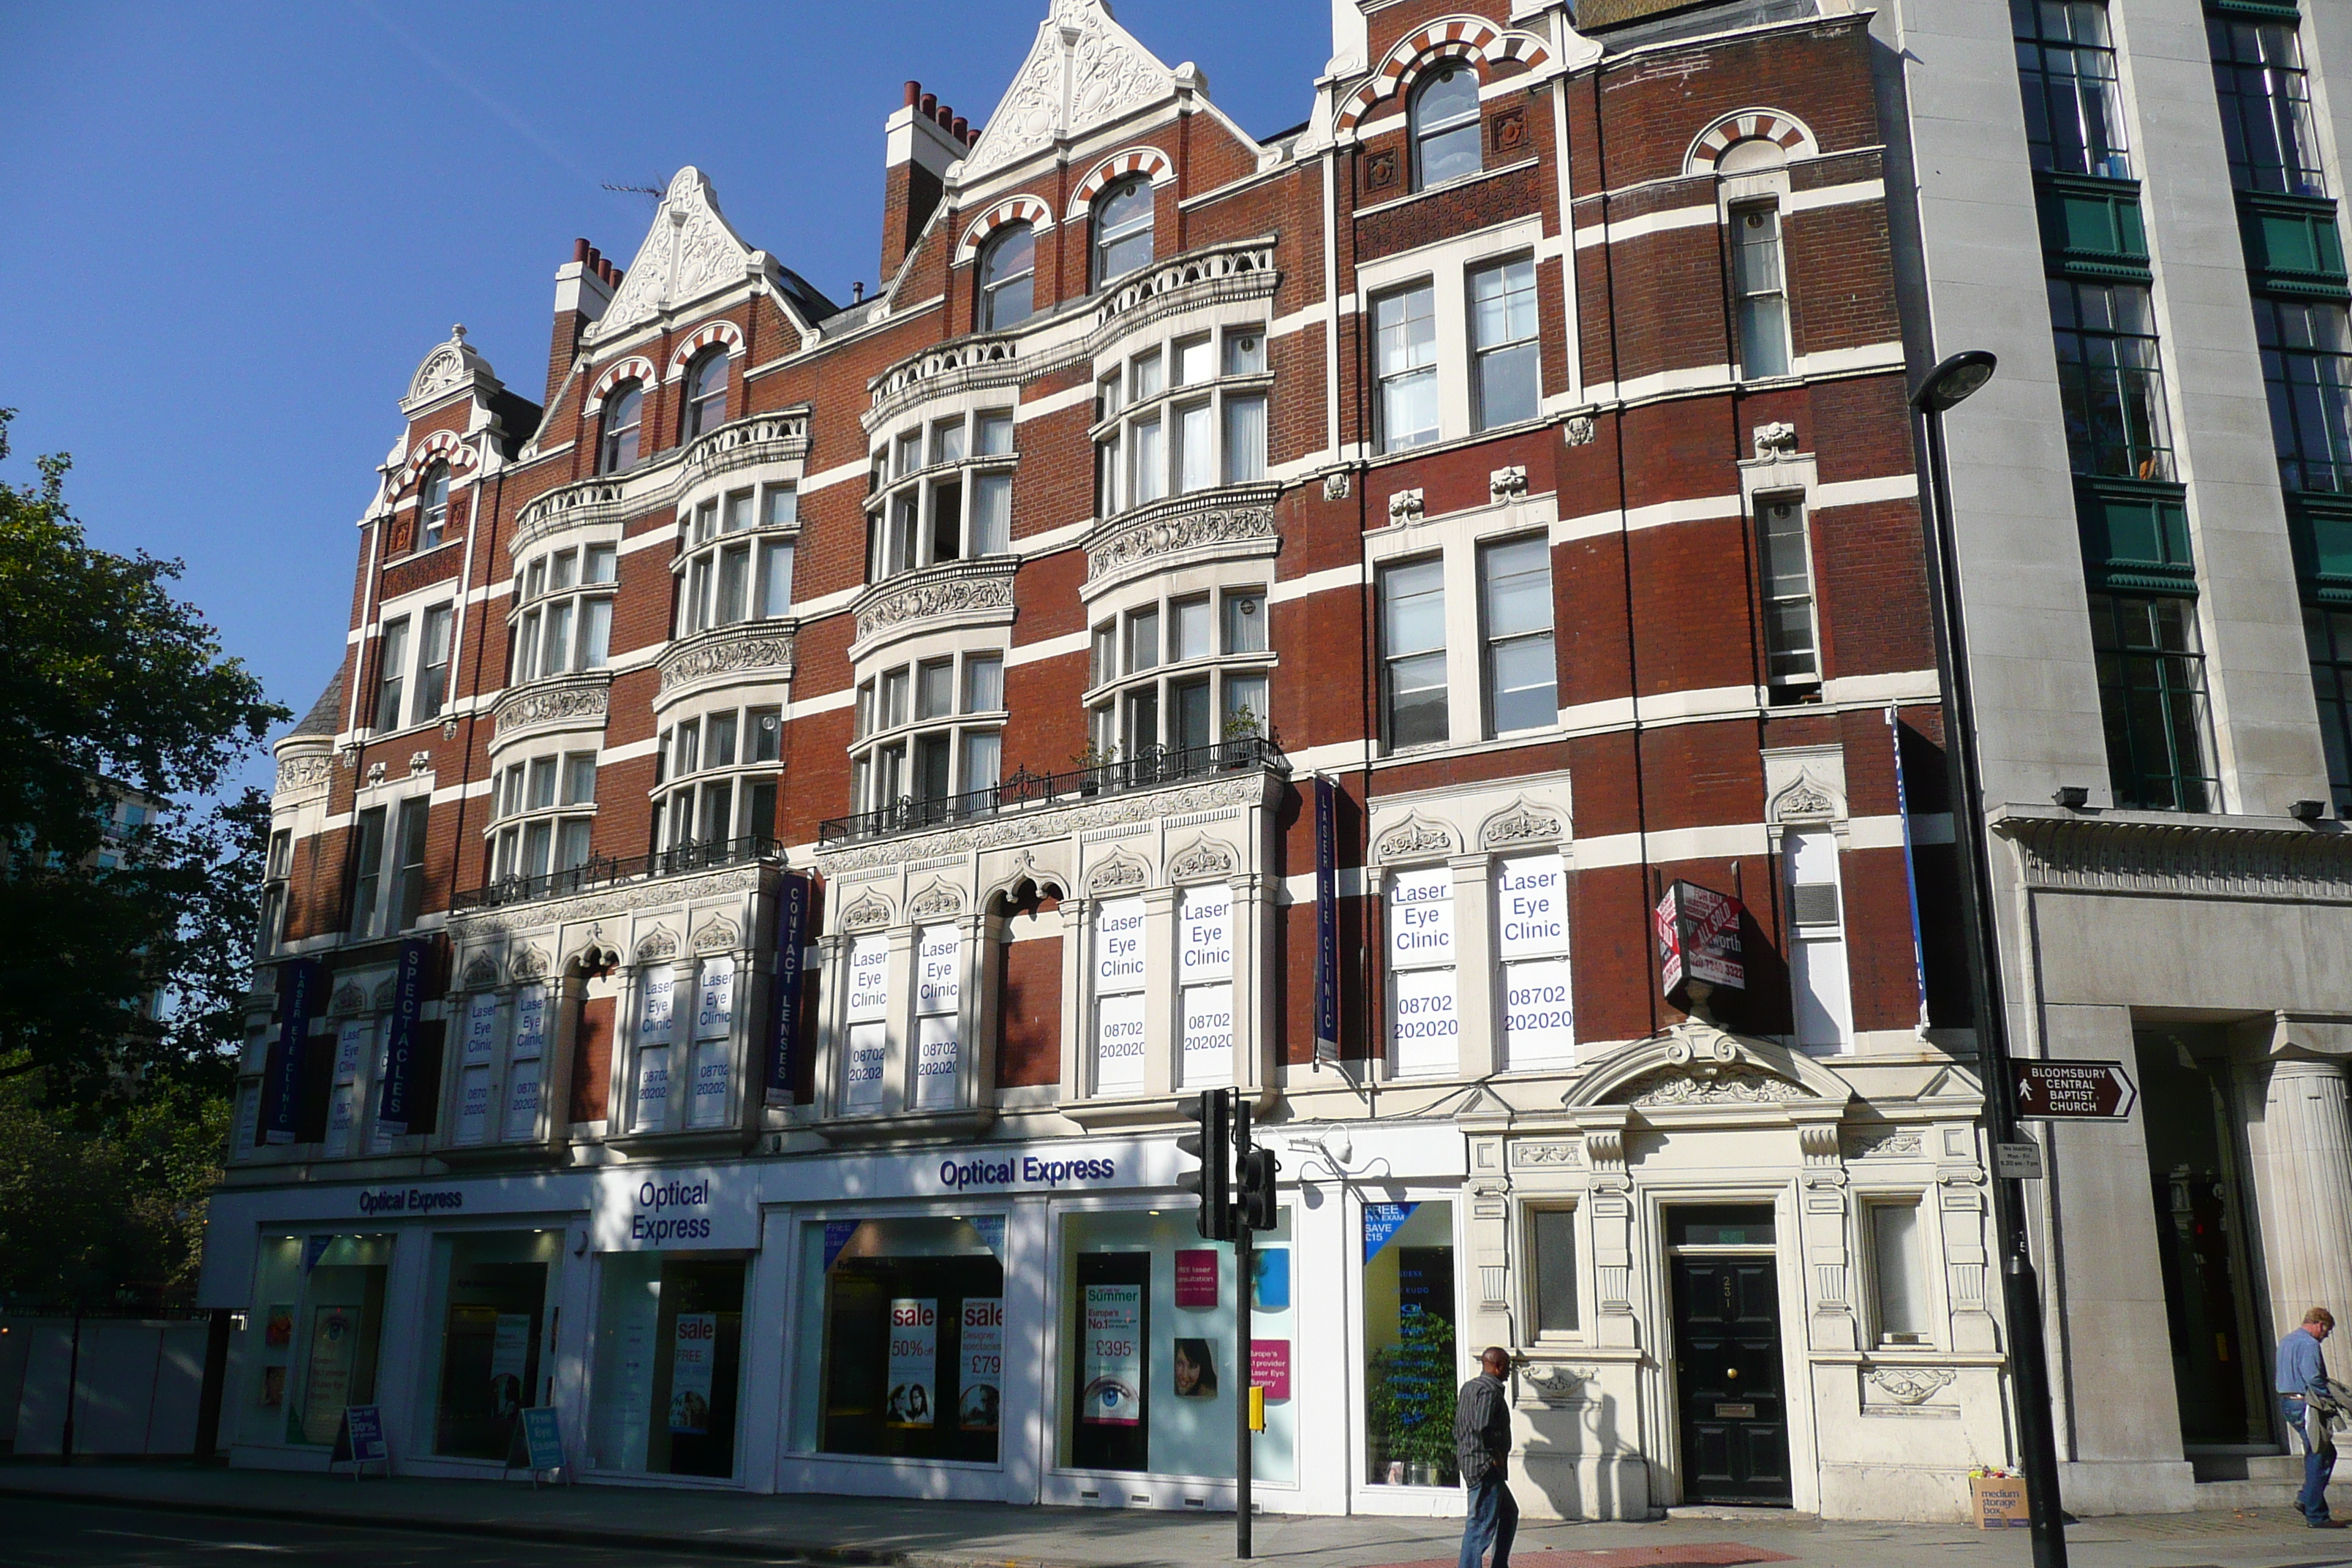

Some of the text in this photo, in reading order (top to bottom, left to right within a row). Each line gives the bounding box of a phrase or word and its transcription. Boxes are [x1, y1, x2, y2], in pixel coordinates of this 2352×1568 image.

[1504, 872, 1557, 891] Laser
[1395, 883, 1447, 902] Laser
[1694, 888, 1708, 901] FOR
[1185, 902, 1229, 920] Laser
[1513, 897, 1550, 918] Eye
[1102, 915, 1143, 932] Laser
[1405, 908, 1439, 928] Eye
[1697, 922, 1712, 947] ALL
[1711, 902, 1731, 932] SOLD
[784, 888, 799, 984] CONTACT
[1193, 926, 1221, 946] Eye
[1505, 920, 1561, 941] Clinic
[1396, 929, 1449, 949] Clinic
[922, 941, 958, 957] Laser
[1109, 938, 1136, 957] Eye
[853, 951, 888, 967] Laser
[1185, 946, 1230, 966] Clinic
[927, 962, 951, 980] Eye
[1101, 957, 1144, 977] Clinic
[1705, 959, 1724, 973] 7240
[1725, 964, 1744, 979] 3322
[703, 972, 733, 987] Laser
[858, 972, 881, 990] Eye
[646, 981, 674, 995] Laser
[921, 983, 957, 999] Clinic
[1509, 986, 1566, 1006] 08702
[706, 992, 727, 1009] Eye
[851, 990, 886, 1008] Clinic
[1398, 995, 1452, 1014] 08702
[649, 1000, 668, 1016] Eye
[524, 1016, 540, 1031] Eye
[643, 1017, 672, 1033] Clinic
[700, 1010, 731, 1025] Clinic
[1188, 1013, 1229, 1030] 08702
[1504, 1010, 1572, 1031] 202020
[343, 1029, 361, 1041] Lase
[391, 950, 419, 1113] SPECTACLES
[475, 1022, 491, 1037] Eye
[778, 995, 791, 1079] LENSES
[1104, 1022, 1142, 1038] 08702
[1394, 1019, 1458, 1039] 202020
[279, 969, 305, 1123] LASER EYE CLINIC
[923, 1041, 957, 1057] 08702
[1185, 1033, 1233, 1051] 202020
[344, 1044, 358, 1058] Eye
[853, 1047, 885, 1063] 08702
[339, 1060, 356, 1073] Clini
[2031, 1068, 2106, 1079] BLOOMSBURY
[517, 1082, 538, 1094] 0870
[2046, 1079, 2096, 1090] CENTRAL
[468, 1088, 486, 1100] 0870
[2050, 1090, 2093, 1101] BAPTIST
[2049, 1101, 2097, 1112] CHURCH
[941, 1156, 1114, 1190] Optical Express
[360, 1189, 462, 1215] Optical Express
[640, 1179, 709, 1213] Optical
[1365, 1205, 1398, 1215] FREE
[632, 1215, 710, 1245] Express
[826, 1222, 851, 1232] FREE
[1365, 1224, 1392, 1232] SAVE
[1365, 1233, 1383, 1242] £15
[1088, 1289, 1138, 1302] Summer
[1722, 1275, 1731, 1308] 231
[893, 1303, 934, 1327] sale
[965, 1303, 1002, 1327] sale
[1088, 1308, 1119, 1317] Europe's
[678, 1319, 713, 1339] sale
[1088, 1318, 1108, 1330] No.1
[963, 1331, 995, 1340] Designer
[676, 1350, 701, 1362] FREE
[892, 1340, 933, 1356] 50% off
[1096, 1340, 1131, 1356] £395
[972, 1355, 1000, 1373] £79
[352, 1421, 376, 1432] 30%
[1981, 1489, 2020, 1498] medium
[1983, 1499, 2016, 1508] storage
[1983, 1504, 2000, 1514] box
